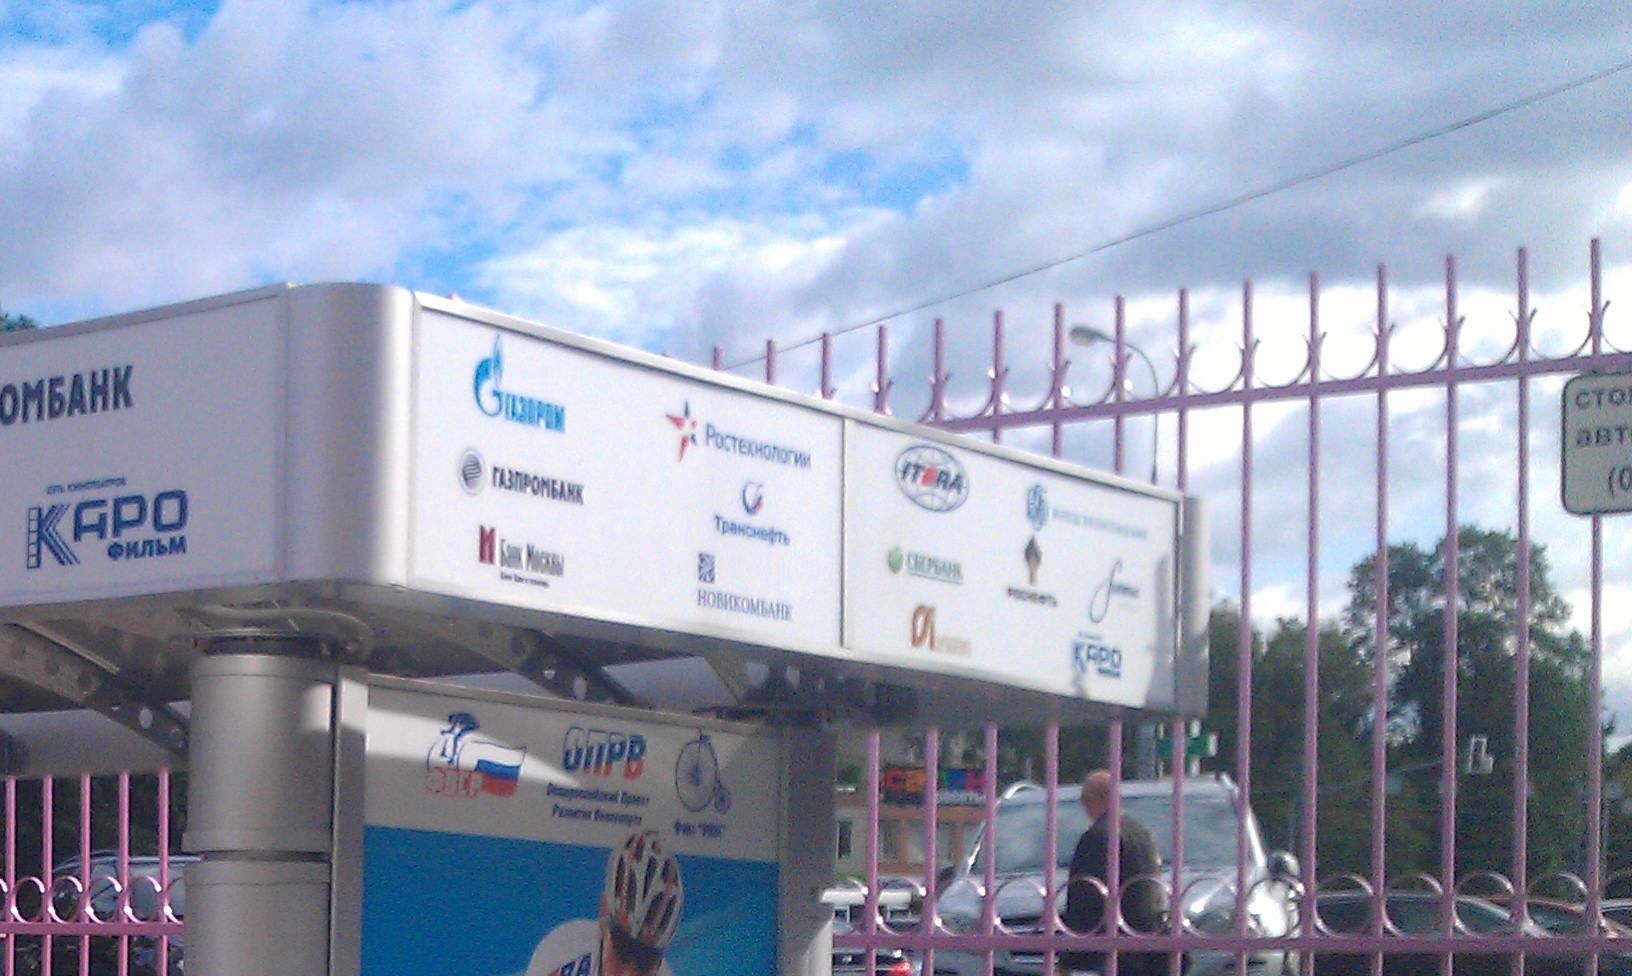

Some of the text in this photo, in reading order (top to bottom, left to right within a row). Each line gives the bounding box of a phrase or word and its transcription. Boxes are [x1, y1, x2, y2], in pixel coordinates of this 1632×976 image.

[1575, 387, 1632, 410] сто
[705, 423, 811, 469] Ростехнологии
[1577, 425, 1632, 448] авт
[492, 464, 584, 506] ГАЗПРОМБАНК
[27, 489, 188, 569] КАРО
[714, 514, 790, 545] Транснефть
[108, 536, 187, 561] ФИЛЬМ
[697, 588, 792, 620] НОВИКОМБАНК
